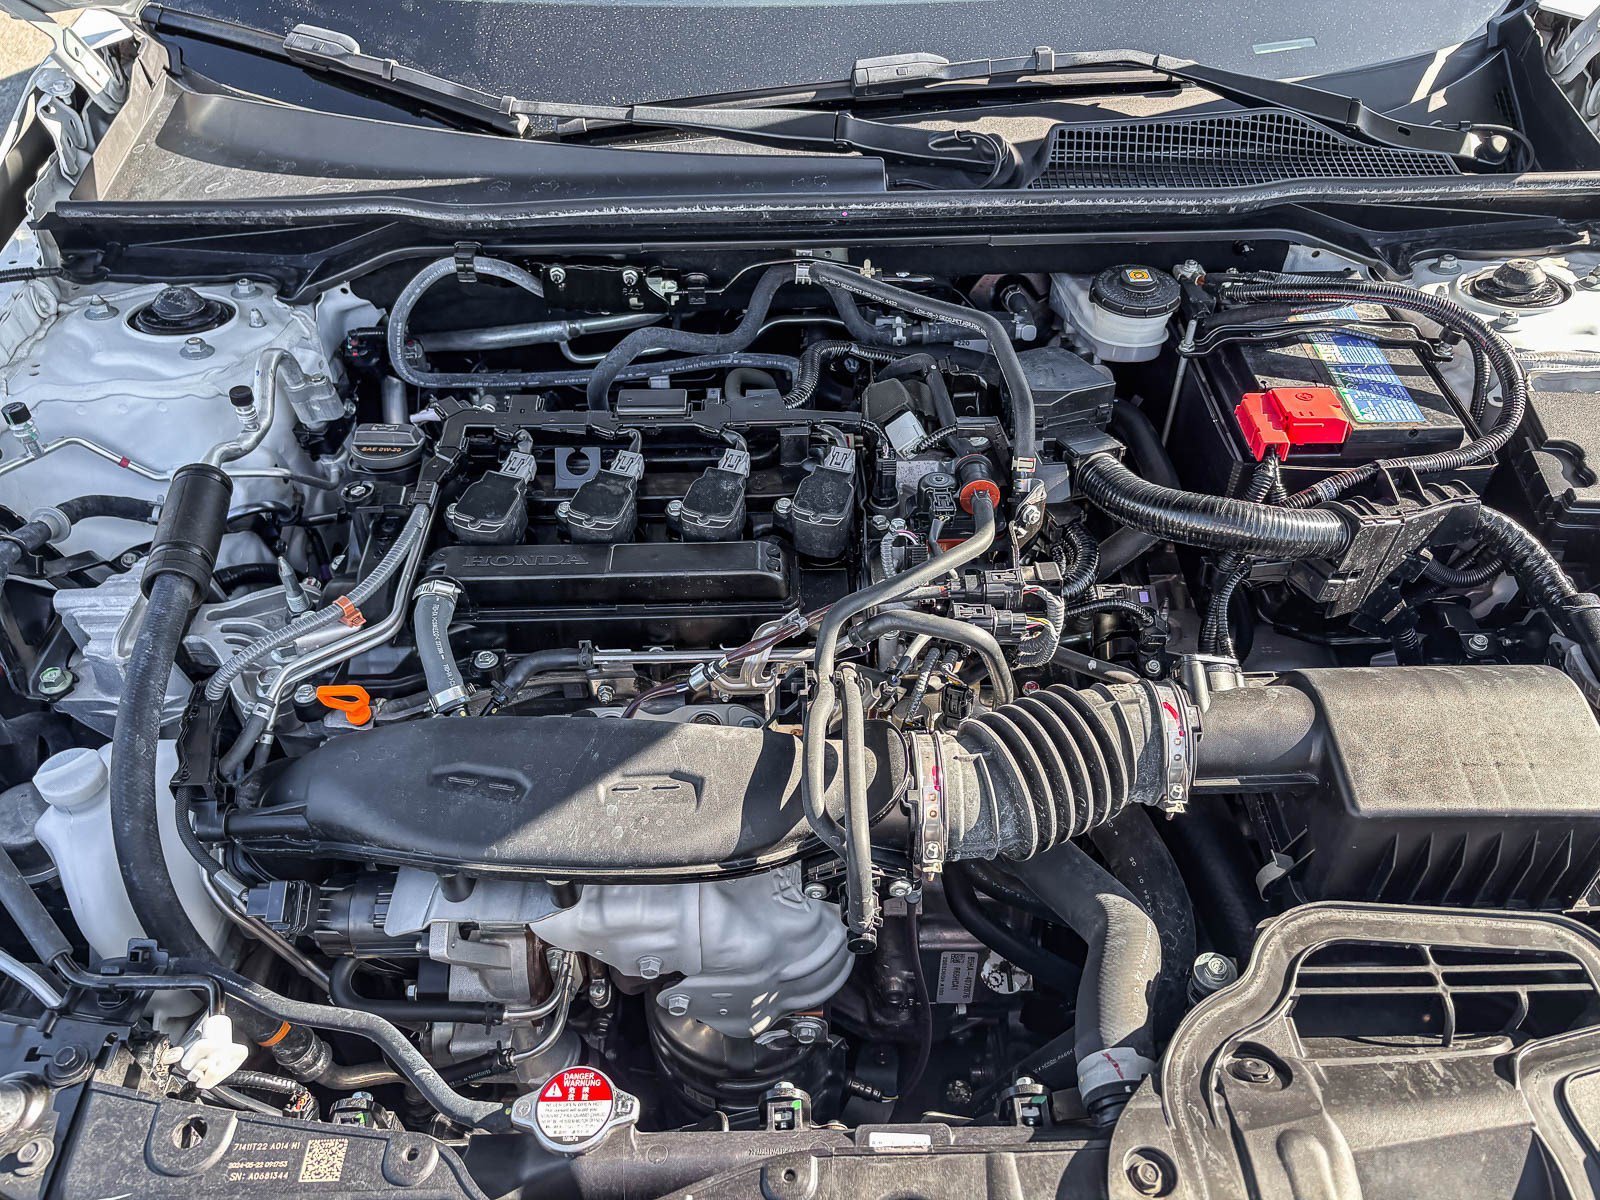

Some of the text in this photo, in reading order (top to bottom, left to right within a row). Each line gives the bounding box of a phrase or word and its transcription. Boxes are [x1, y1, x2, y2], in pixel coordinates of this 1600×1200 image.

[462, 555, 589, 567] HONDA
[563, 1072, 595, 1080] DANGER
[563, 1079, 601, 1087] WARNUNG
[269, 1142, 289, 1150] A014
[229, 1171, 289, 1181] SN: A0681344
